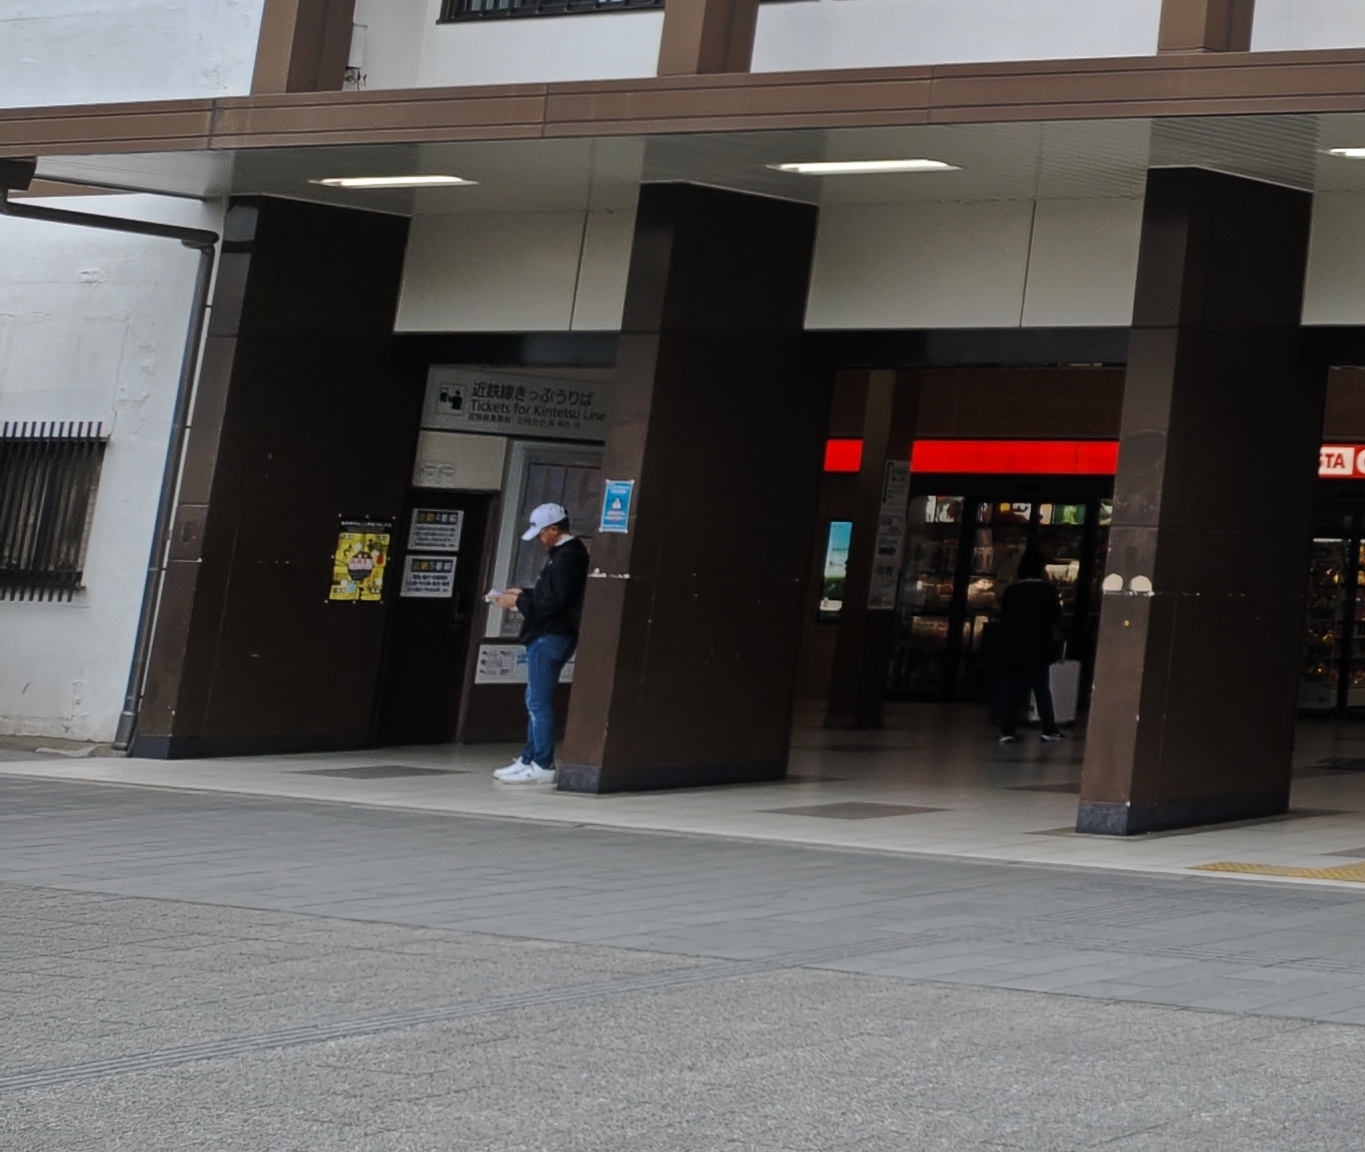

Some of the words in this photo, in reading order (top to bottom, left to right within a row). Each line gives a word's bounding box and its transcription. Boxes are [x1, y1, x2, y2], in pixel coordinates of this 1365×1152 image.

[471, 399, 510, 414] Tickets
[513, 403, 531, 416] for
[534, 404, 581, 420] Kintetsu
[583, 408, 607, 422] Line
